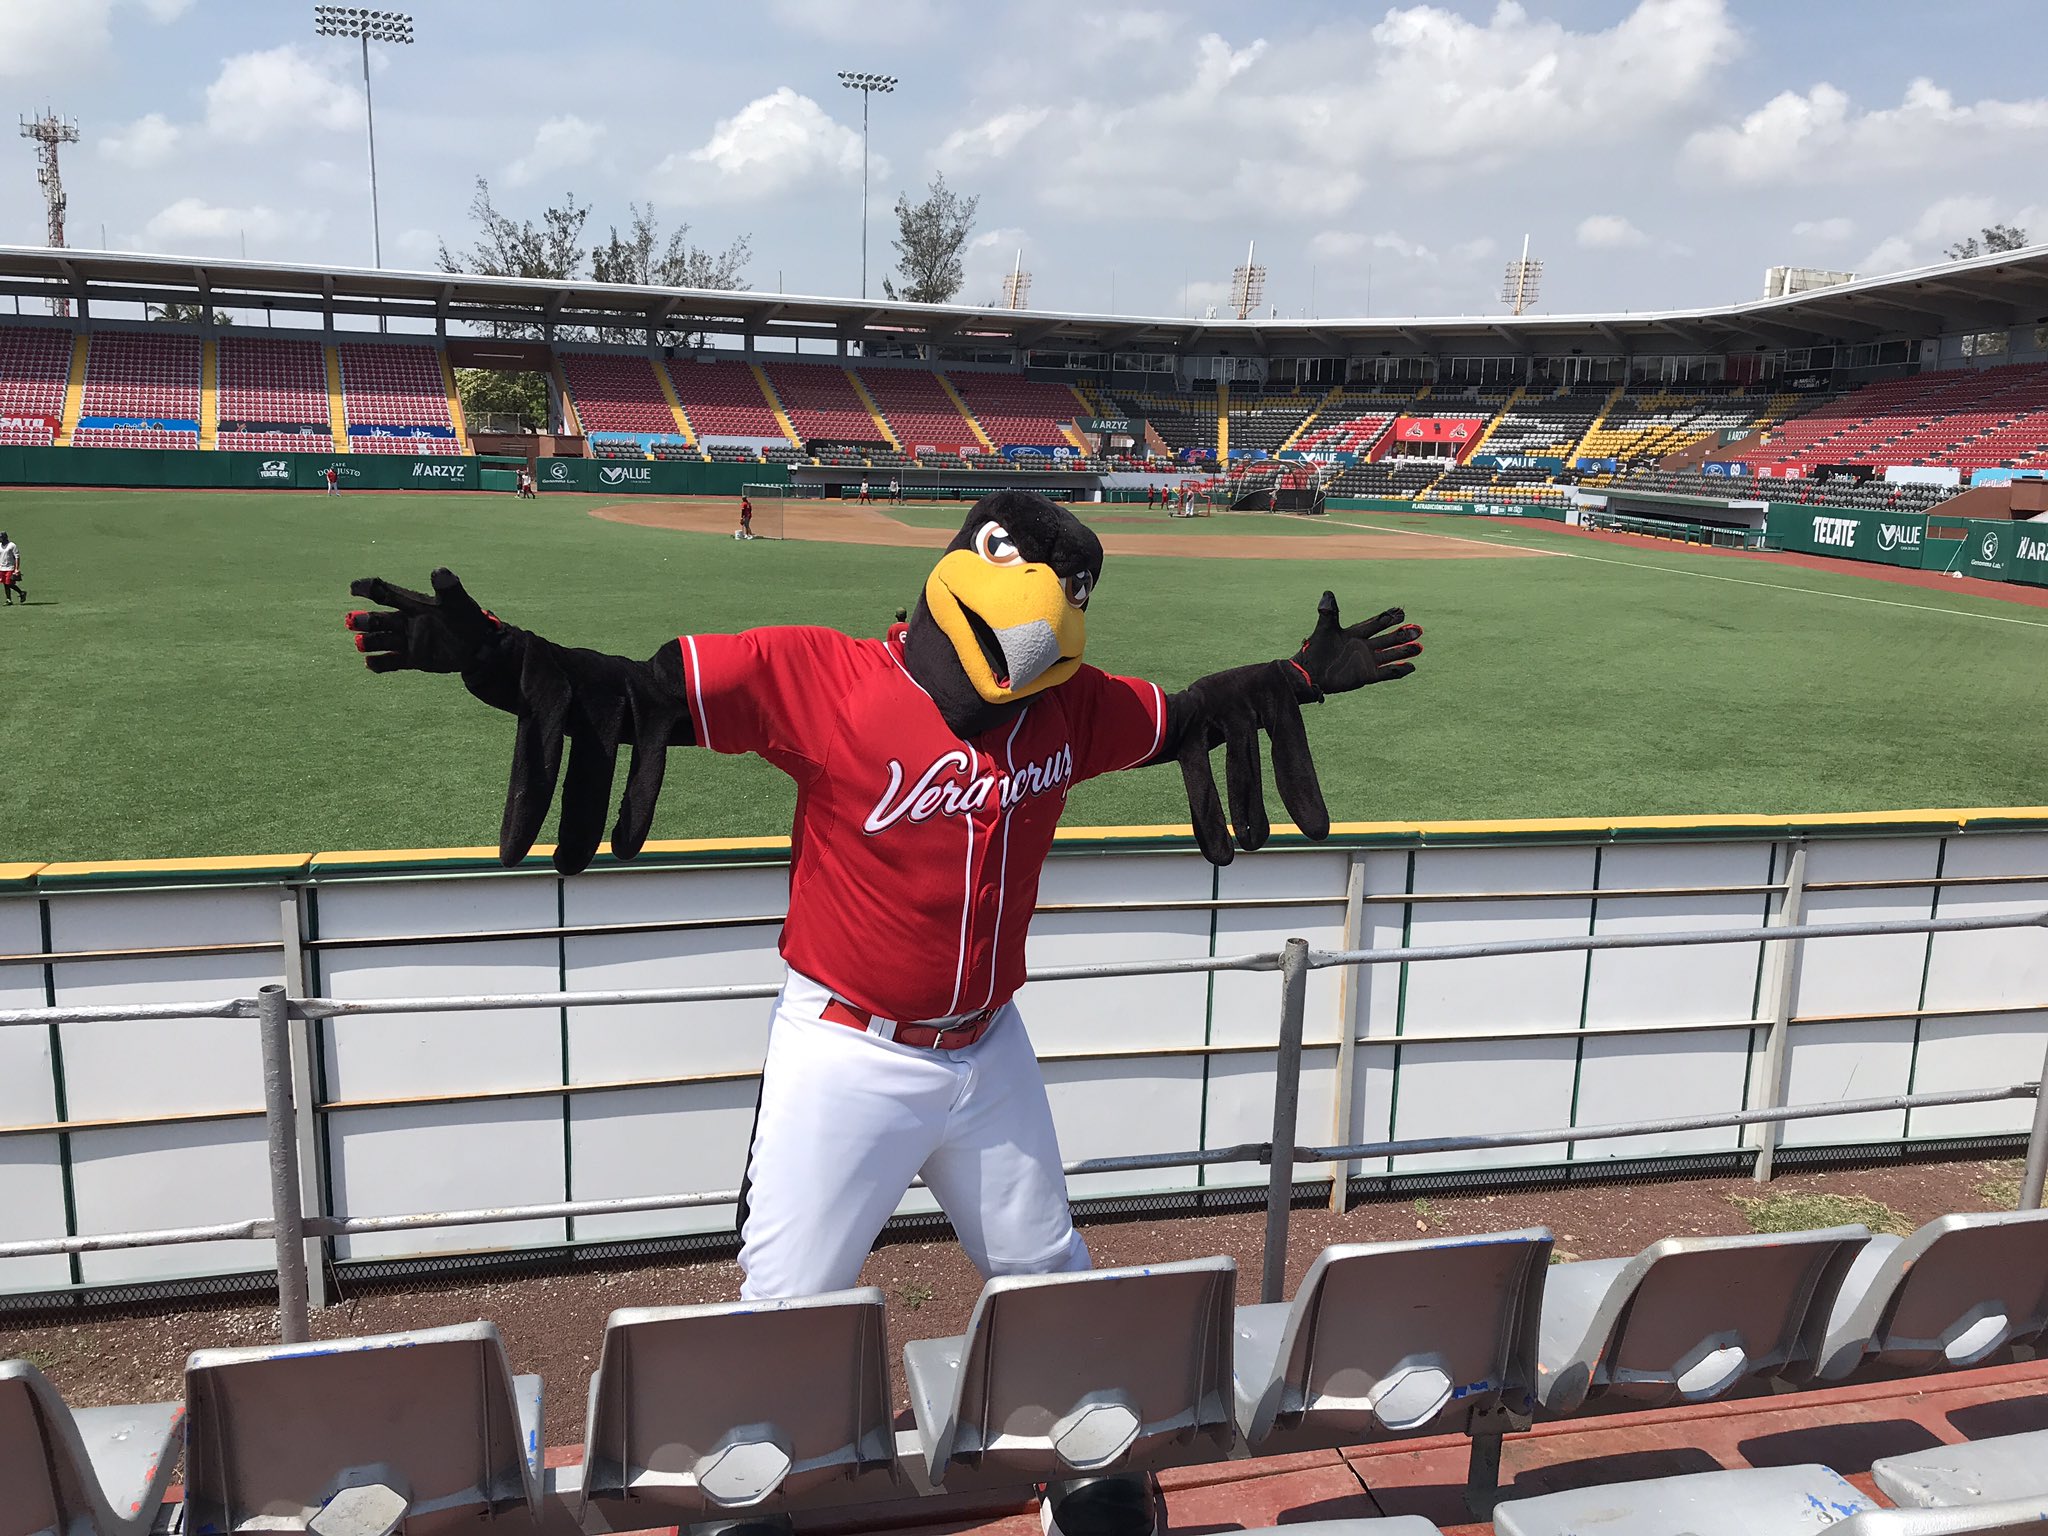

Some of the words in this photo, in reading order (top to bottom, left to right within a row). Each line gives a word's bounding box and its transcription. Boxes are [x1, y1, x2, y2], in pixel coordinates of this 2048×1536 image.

[1099, 421, 1128, 430] ARZYZ
[423, 465, 465, 477] ARZYZ
[601, 466, 652, 482] VALUE
[1812, 516, 1858, 548] TECATE
[1880, 523, 1922, 546] VALUE
